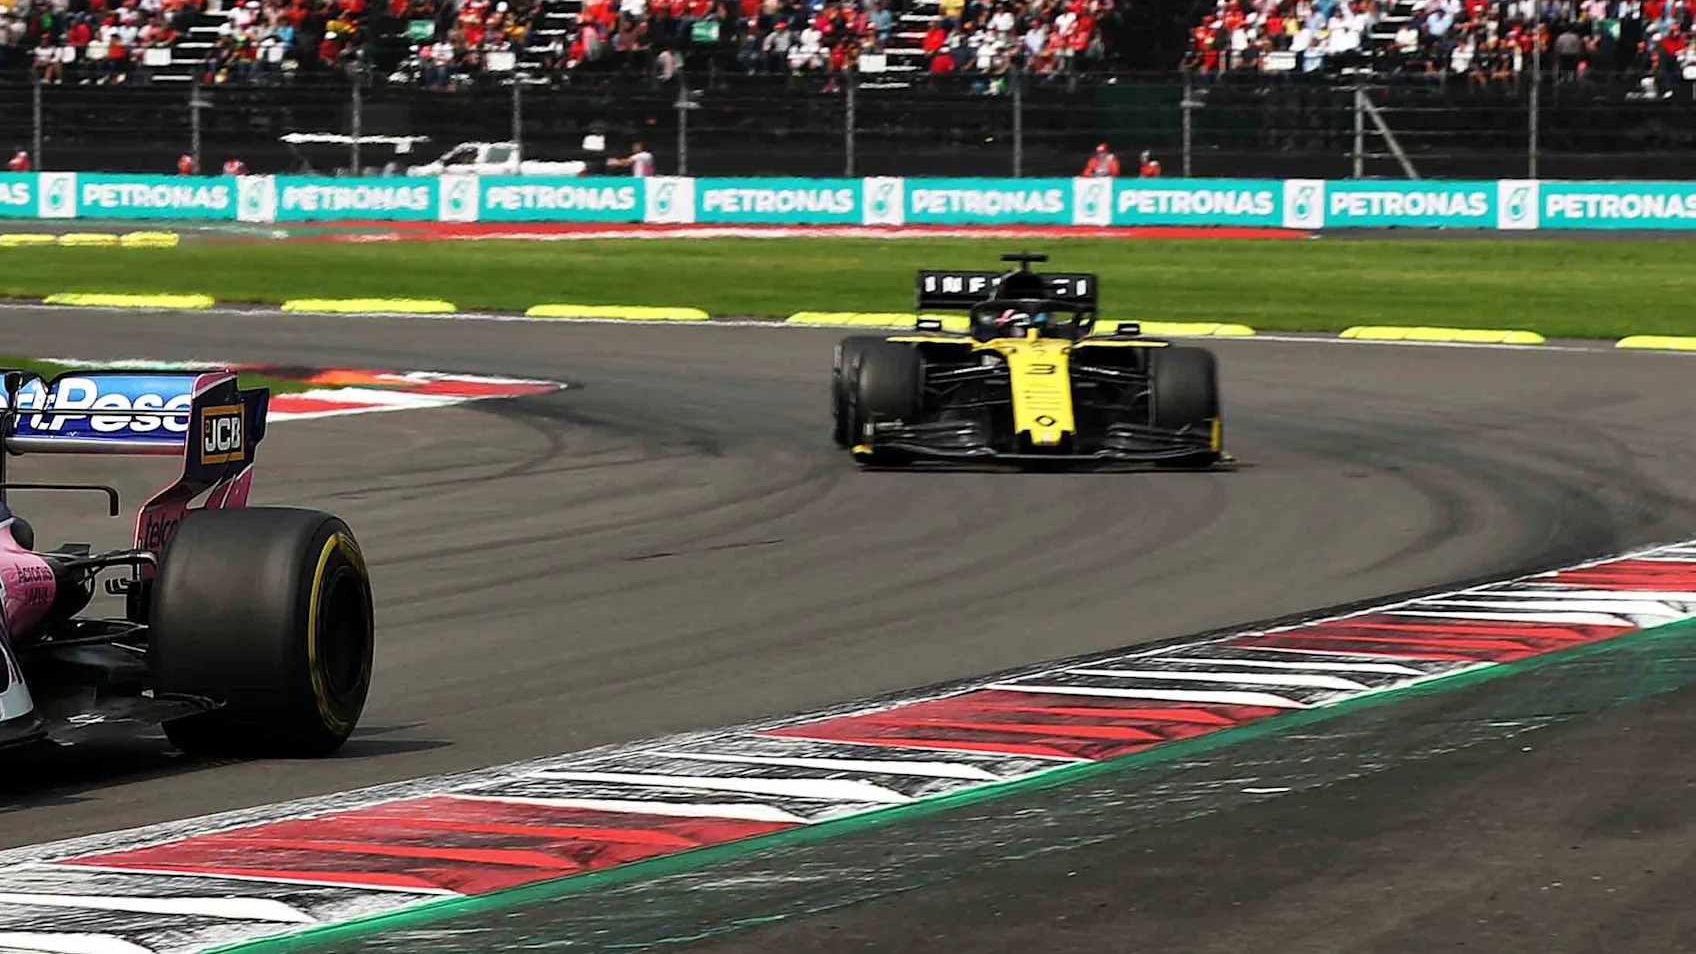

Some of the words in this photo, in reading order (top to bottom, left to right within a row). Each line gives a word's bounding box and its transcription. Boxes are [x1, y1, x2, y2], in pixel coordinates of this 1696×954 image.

[83, 184, 229, 209] PETRONAS
[282, 185, 430, 210] PETRONAS
[487, 185, 636, 211] PETRONAS
[704, 189, 855, 214] PETRONAS
[912, 189, 1064, 215] PETRONAS
[1118, 190, 1274, 215] PETRONAS
[1330, 192, 1488, 216] PETRONAS
[1546, 194, 1696, 218] PETRONAS
[925, 276, 1087, 296] INFTI
[205, 417, 241, 452] JCB
